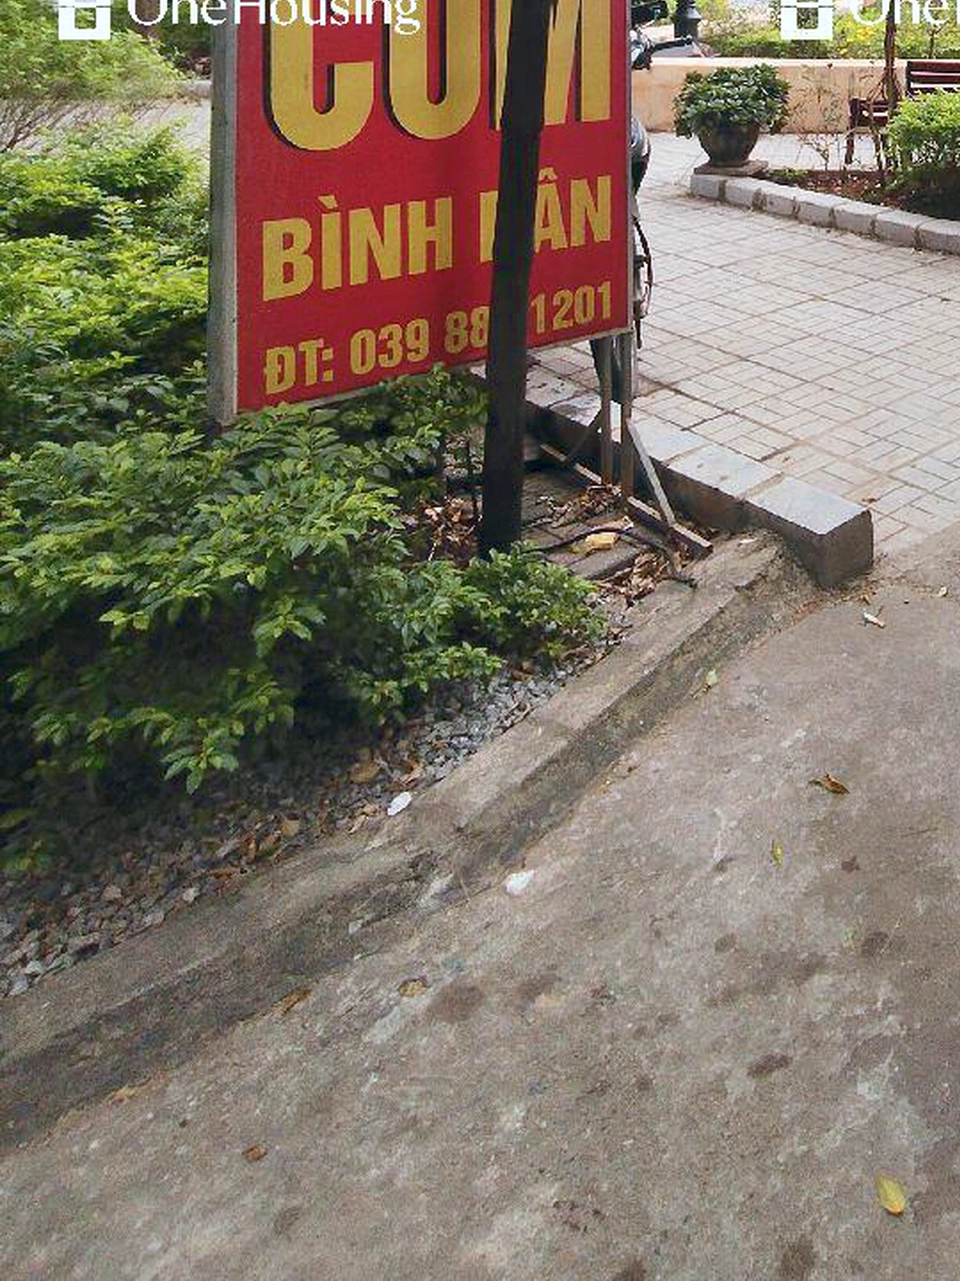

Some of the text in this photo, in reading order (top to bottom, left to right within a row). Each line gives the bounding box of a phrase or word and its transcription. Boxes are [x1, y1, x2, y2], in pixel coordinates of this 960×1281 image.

[262, 194, 453, 301] BÌNH
[264, 339, 334, 394] ĐT:
[350, 318, 430, 375] 039
[530, 281, 611, 334] 1201
